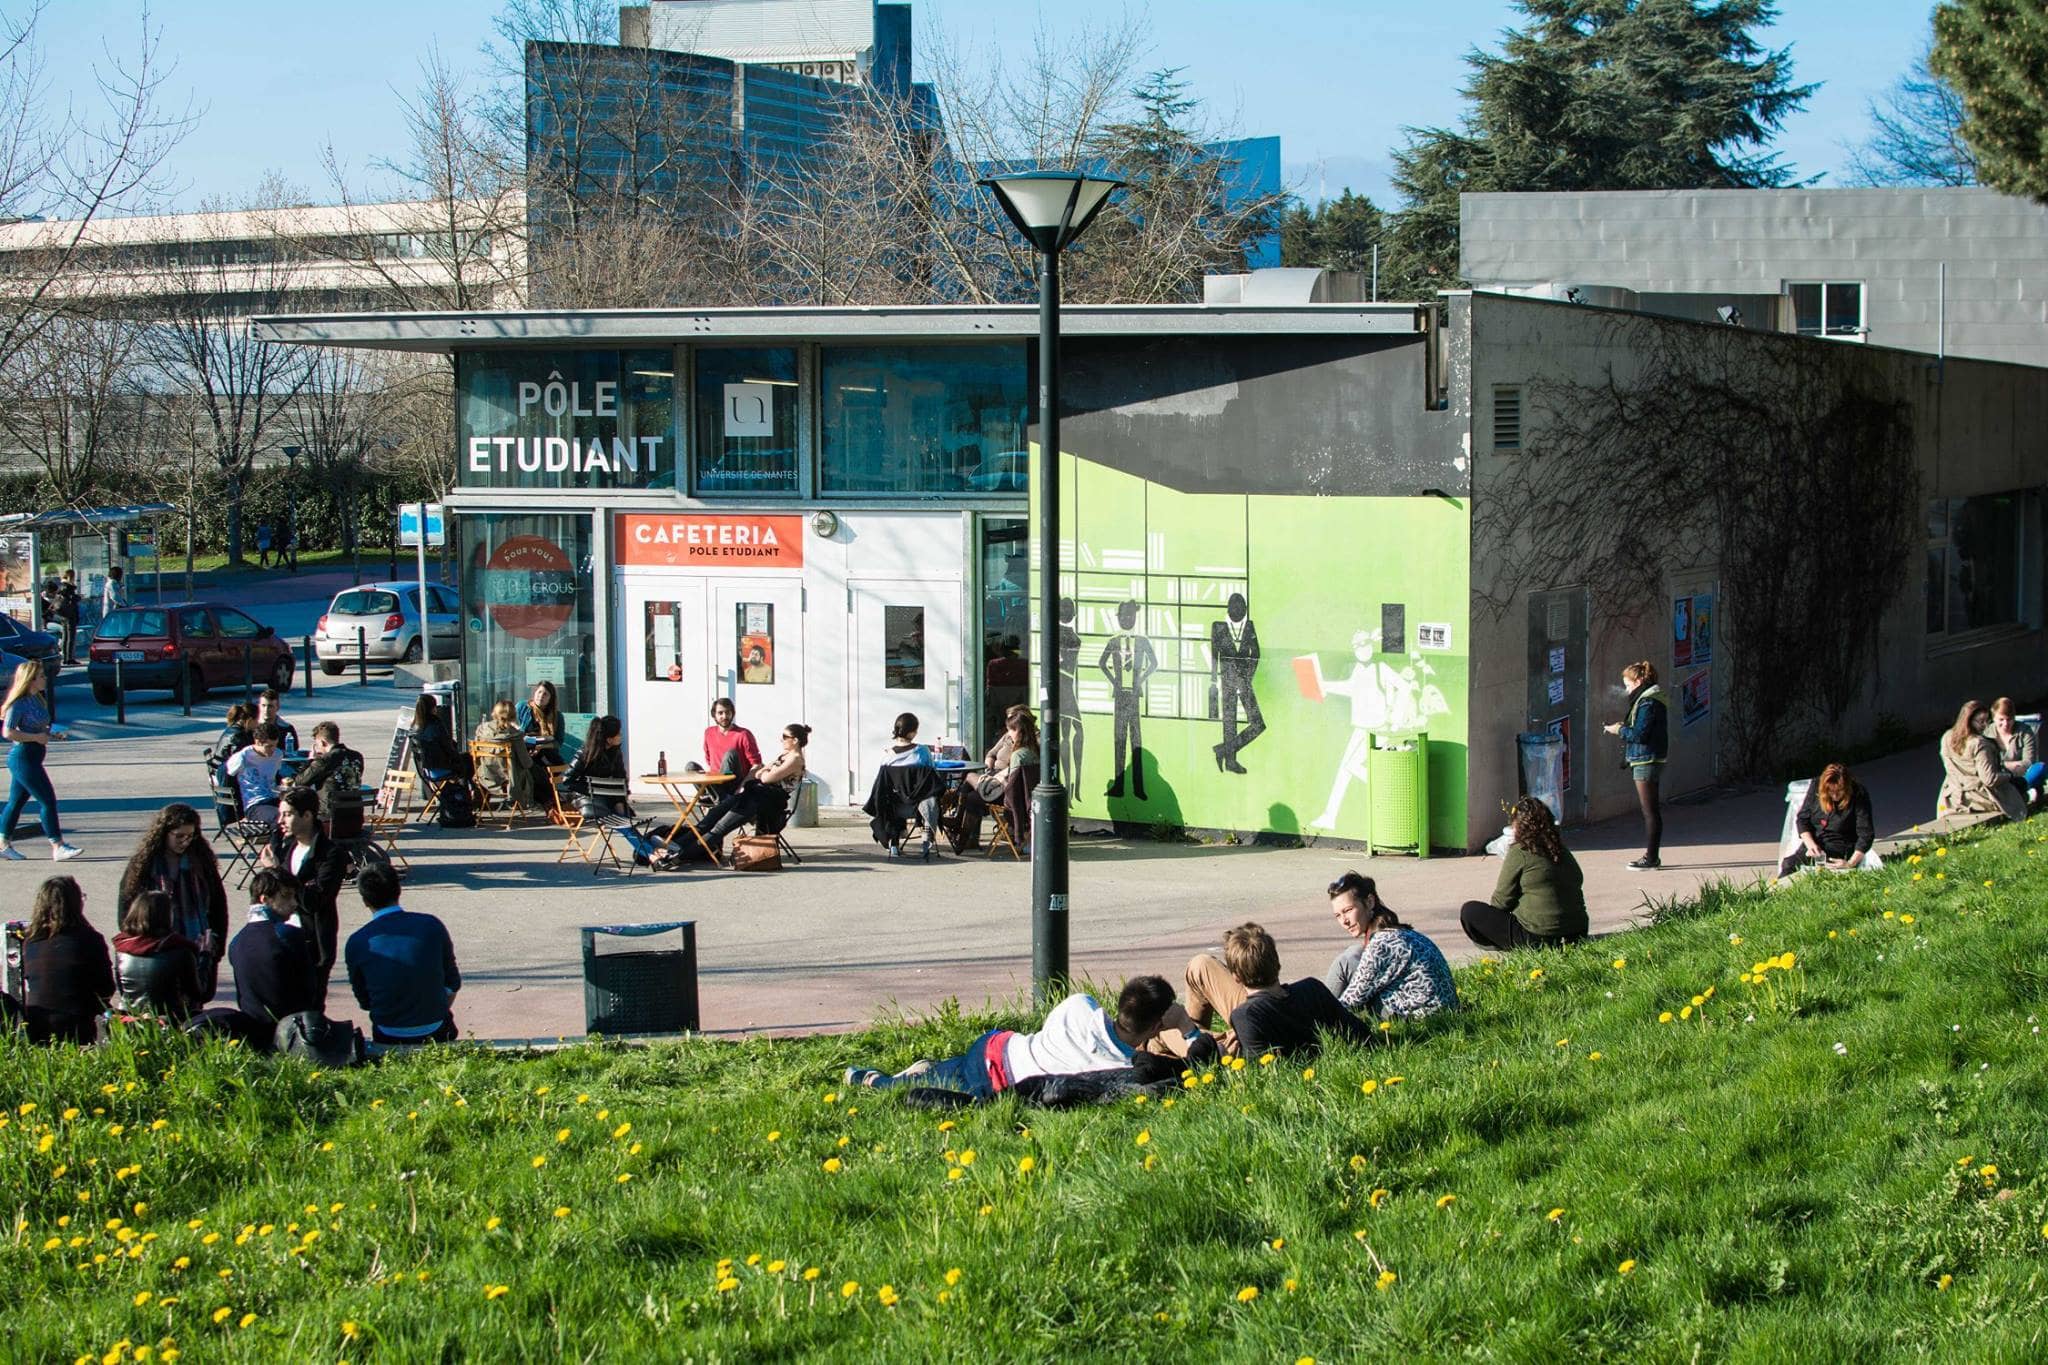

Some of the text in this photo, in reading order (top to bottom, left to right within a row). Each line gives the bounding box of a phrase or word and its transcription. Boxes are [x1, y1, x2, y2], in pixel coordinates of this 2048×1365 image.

[519, 371, 617, 417] PÔLE
[469, 437, 664, 473] ETUDIANT
[751, 471, 762, 480] DE
[764, 471, 798, 480] NANTES
[635, 525, 778, 545] CAFETERIA
[531, 547, 555, 563] VOUS
[689, 547, 780, 557] POLE ETUDIANT
[532, 582, 574, 594] CROUS
